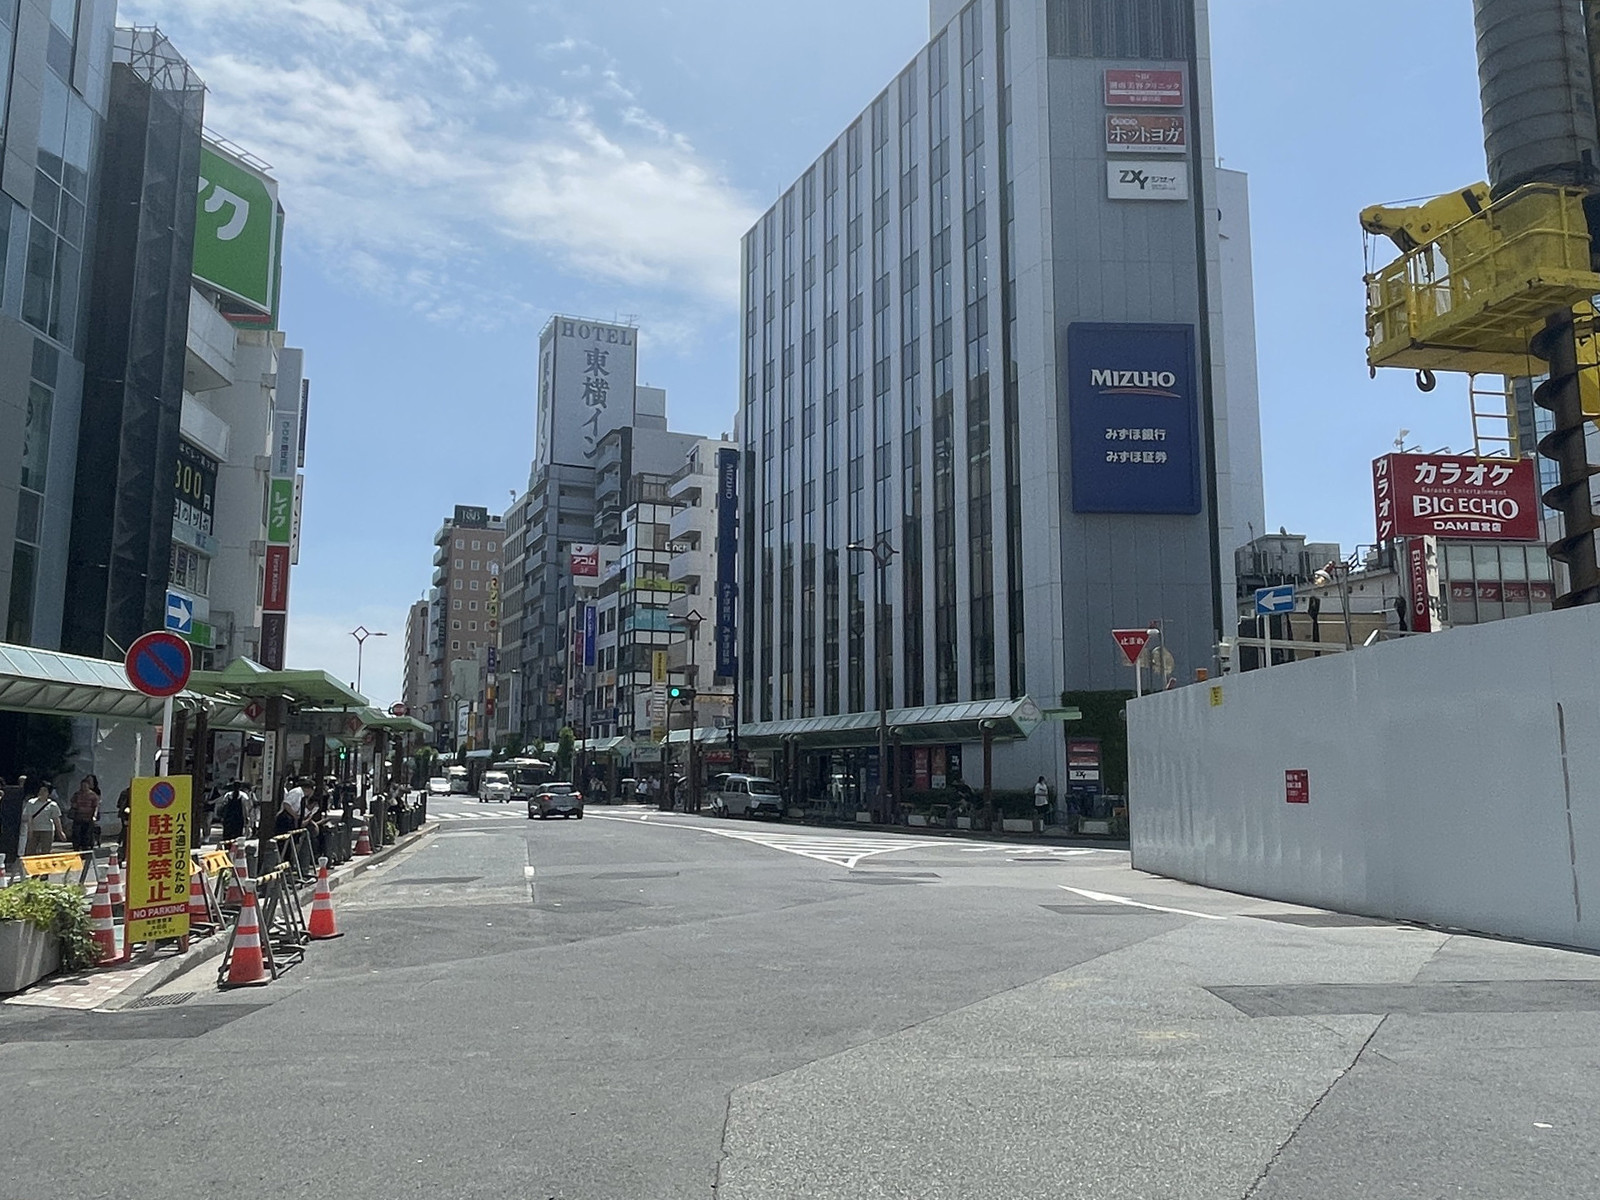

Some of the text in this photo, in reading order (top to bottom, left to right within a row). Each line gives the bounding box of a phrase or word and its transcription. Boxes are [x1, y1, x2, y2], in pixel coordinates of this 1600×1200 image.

[1110, 126, 1183, 143] ホットヨガ
[561, 321, 633, 346] HOTEL
[1091, 368, 1176, 387] MIZUHO
[581, 347, 610, 459] 東横イン
[1105, 428, 1166, 441] みずほ銀行
[1106, 450, 1168, 463] みずほ証券
[1414, 461, 1513, 487] カラオケ
[1376, 458, 1392, 538] カラオケ
[1421, 486, 1507, 496] Karaoke Entertainment
[272, 491, 288, 528] レイク
[1412, 494, 1519, 520] BIG ECHO
[572, 556, 596, 565] アコム
[1120, 636, 1145, 645] 止まれ
[147, 813, 173, 903] 駐車禁止
[174, 812, 187, 894] バス通行のため
[133, 903, 186, 919] NO PARKING
